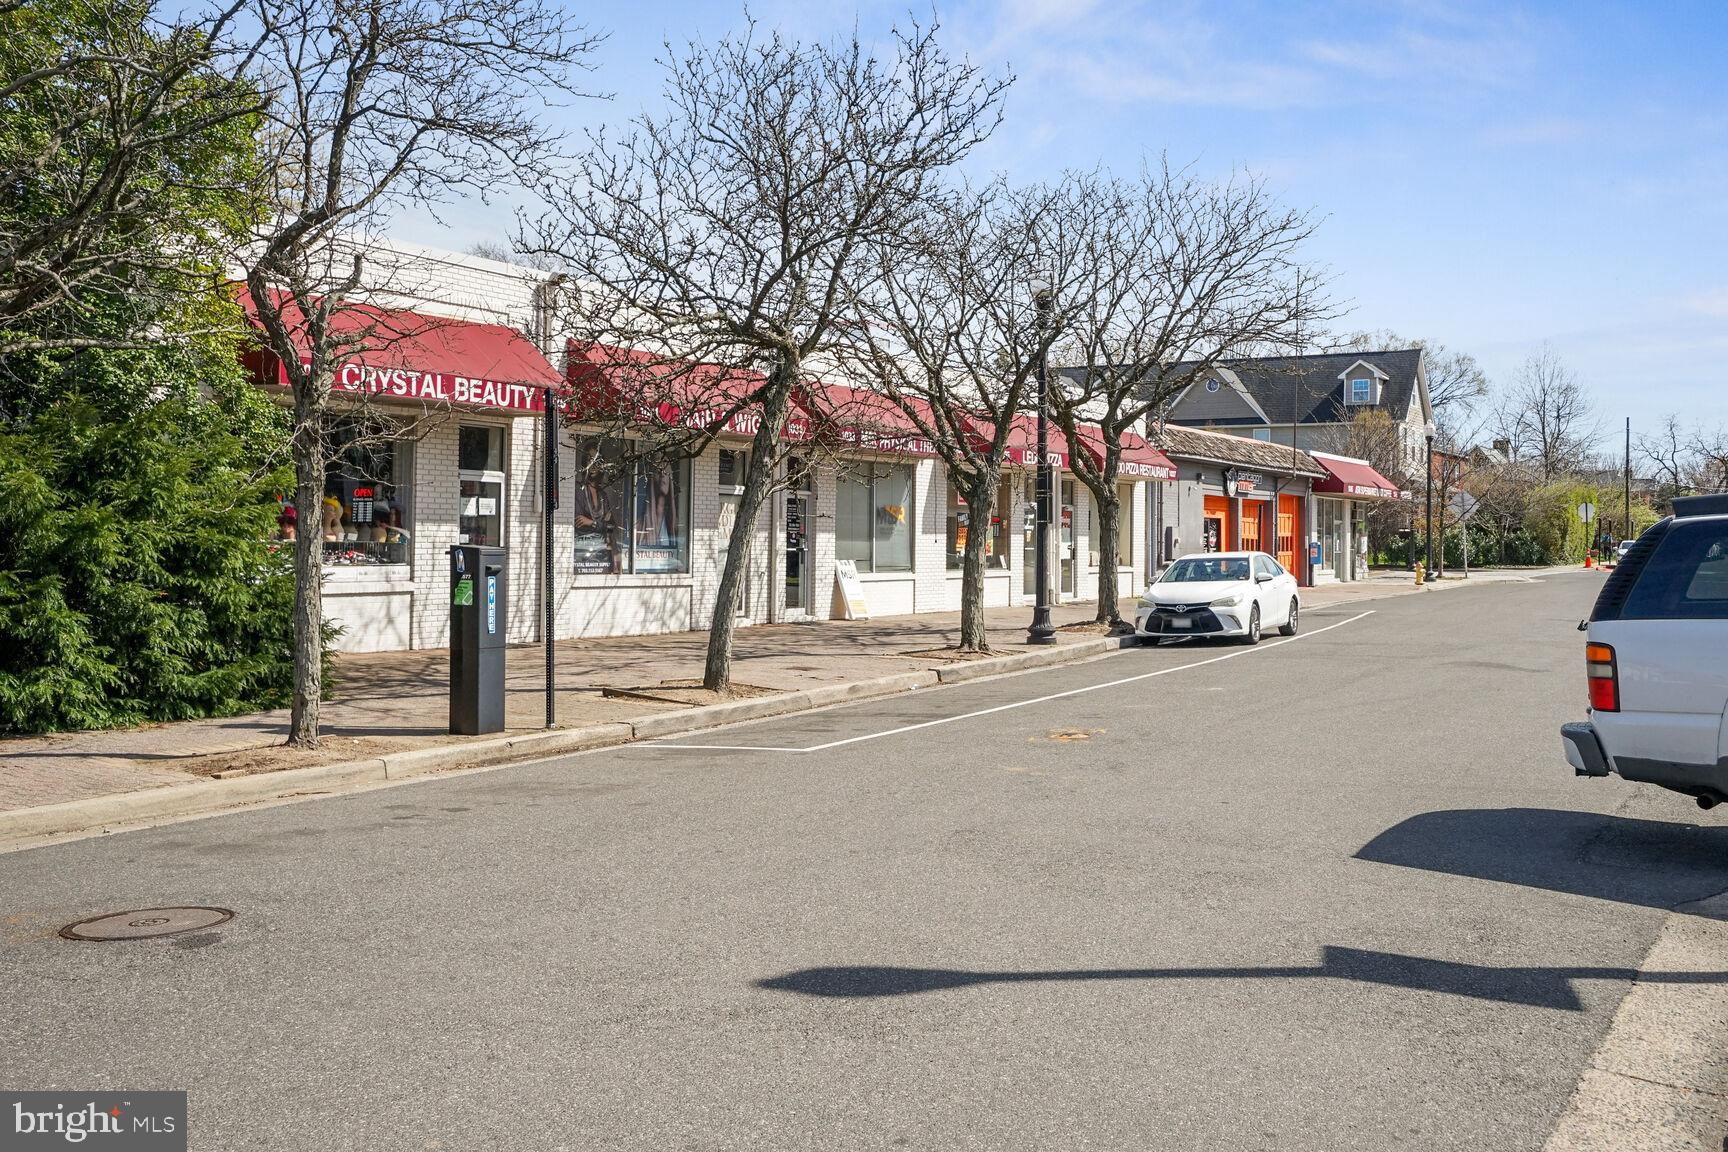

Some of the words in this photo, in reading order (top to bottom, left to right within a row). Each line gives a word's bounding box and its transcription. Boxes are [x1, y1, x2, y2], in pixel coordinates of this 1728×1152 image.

[341, 363, 447, 398] CRYSTAL
[454, 376, 535, 409] BEAUTY
[1125, 461, 1139, 475] PIZZA
[1139, 463, 1169, 479] RESTAURANT
[353, 487, 374, 497] OPEN
